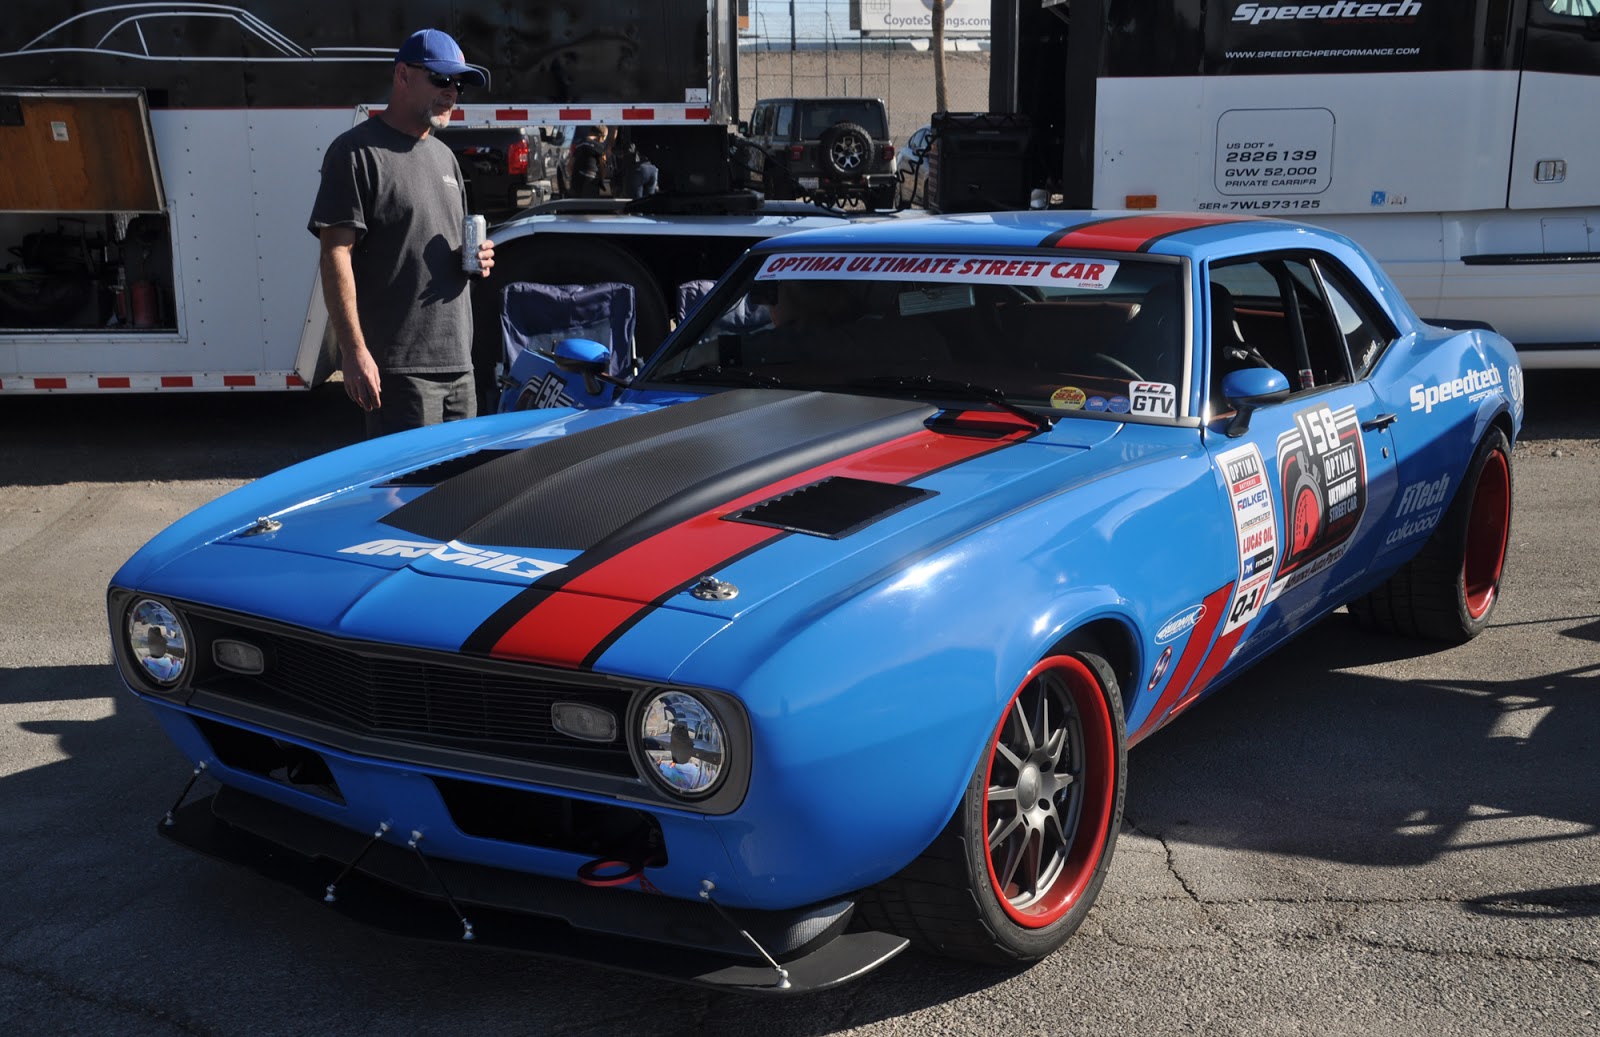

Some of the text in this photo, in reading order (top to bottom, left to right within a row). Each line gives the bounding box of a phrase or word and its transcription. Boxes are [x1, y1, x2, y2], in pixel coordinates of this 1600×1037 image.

[883, 14, 990, 27] CoyoteSngs.com
[1232, 0, 1422, 24] Speedtech
[1225, 48, 1420, 58] WWW.SPEEDTECHPERFORMANCE.COM
[1226, 150, 1317, 162] 2826139
[1225, 167, 1317, 177] GVW 52,000
[1225, 179, 1268, 187] PRIVATE
[767, 256, 1105, 281] OPTIMA ULTIMATE STREET CAR
[1410, 362, 1502, 414] Speedtech
[1132, 395, 1174, 414] GTV
[1297, 407, 1340, 456] 158
[1229, 456, 1258, 481] OPTIMA
[1325, 449, 1355, 480] OPTIMA
[1237, 489, 1268, 511] FALKEN
[1328, 477, 1357, 507] ULTIMATE
[1329, 495, 1358, 523] STREET CAR
[1243, 526, 1273, 554] LUCAS OIL
[1230, 583, 1267, 624] QA1
